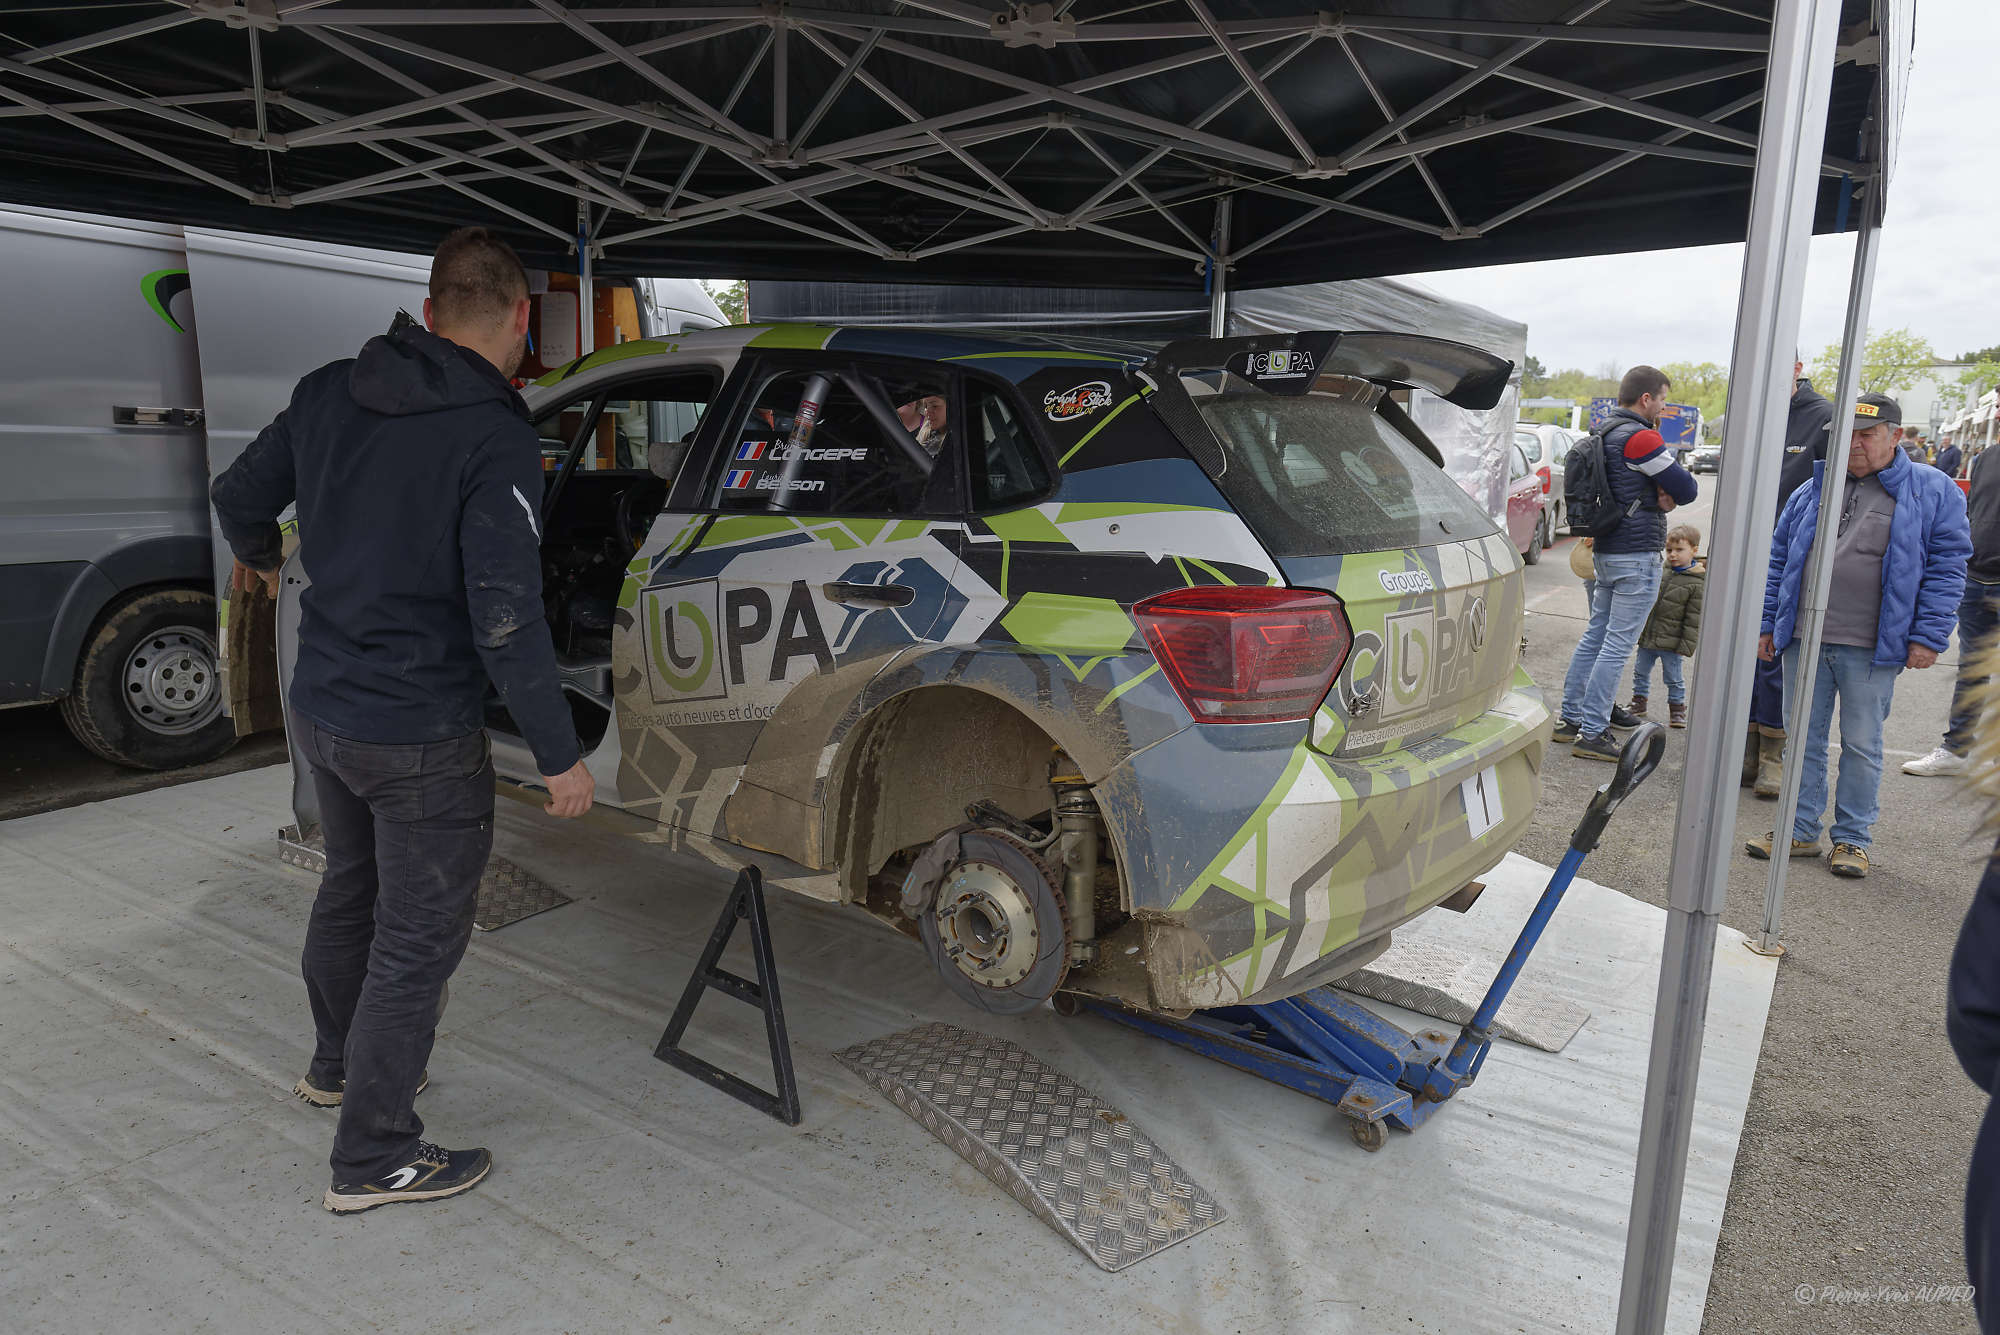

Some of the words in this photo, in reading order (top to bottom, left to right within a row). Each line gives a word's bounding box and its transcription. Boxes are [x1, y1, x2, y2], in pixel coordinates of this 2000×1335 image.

[1380, 572, 1432, 594] Groupe
[656, 711, 683, 726] auto
[684, 707, 726, 725] neuves
[728, 705, 742, 721] et
[1476, 771, 1491, 826] 1
